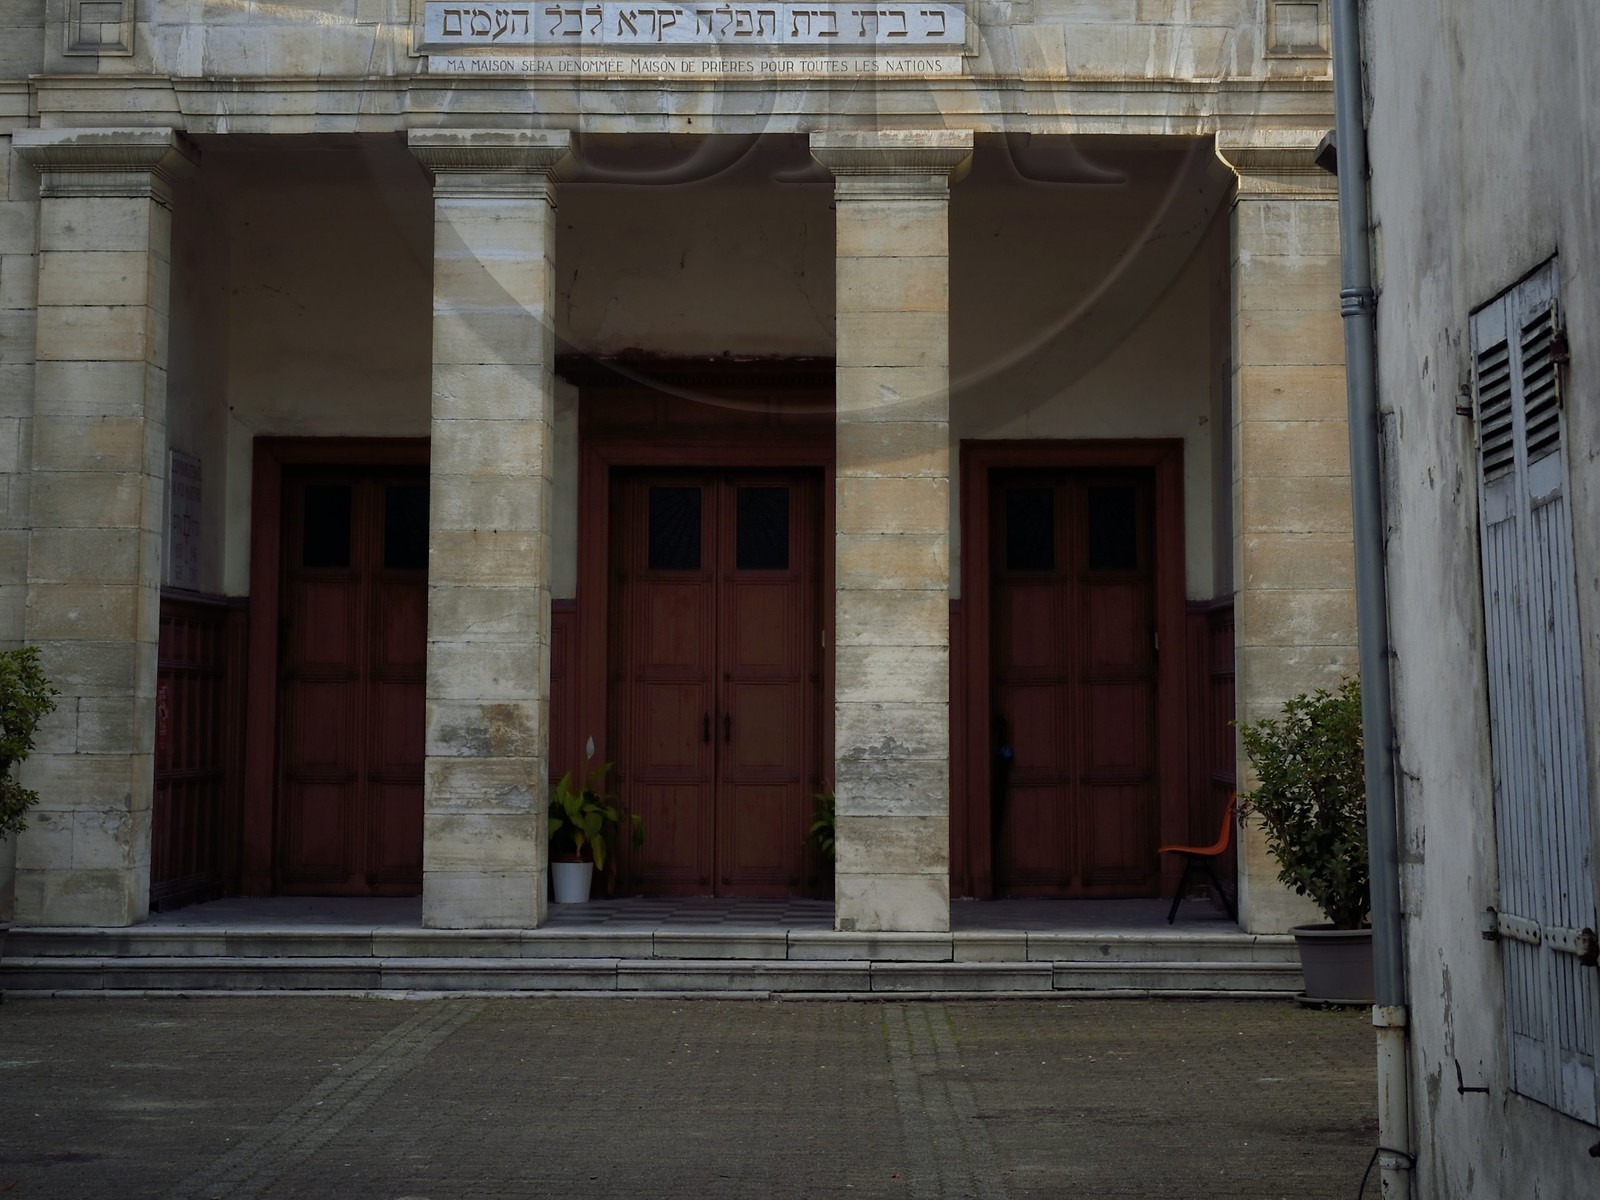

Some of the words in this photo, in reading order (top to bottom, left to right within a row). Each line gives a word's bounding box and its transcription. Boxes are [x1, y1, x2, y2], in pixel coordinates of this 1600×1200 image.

[442, 8, 529, 41] העמים
[545, 3, 602, 36] לכל
[617, 9, 683, 41] יקרא
[791, 10, 839, 37] בית
[852, 10, 908, 37] ביתי
[920, 10, 946, 36] כי
[447, 60, 465, 71] MA
[471, 60, 514, 71] MAISON
[522, 60, 553, 72] SERA
[631, 58, 675, 73] MAISON
[681, 60, 695, 72] DE
[761, 61, 794, 72] POUR
[800, 60, 848, 72] TOUTES
[855, 60, 879, 72] LES
[886, 60, 943, 72] NATIONS
